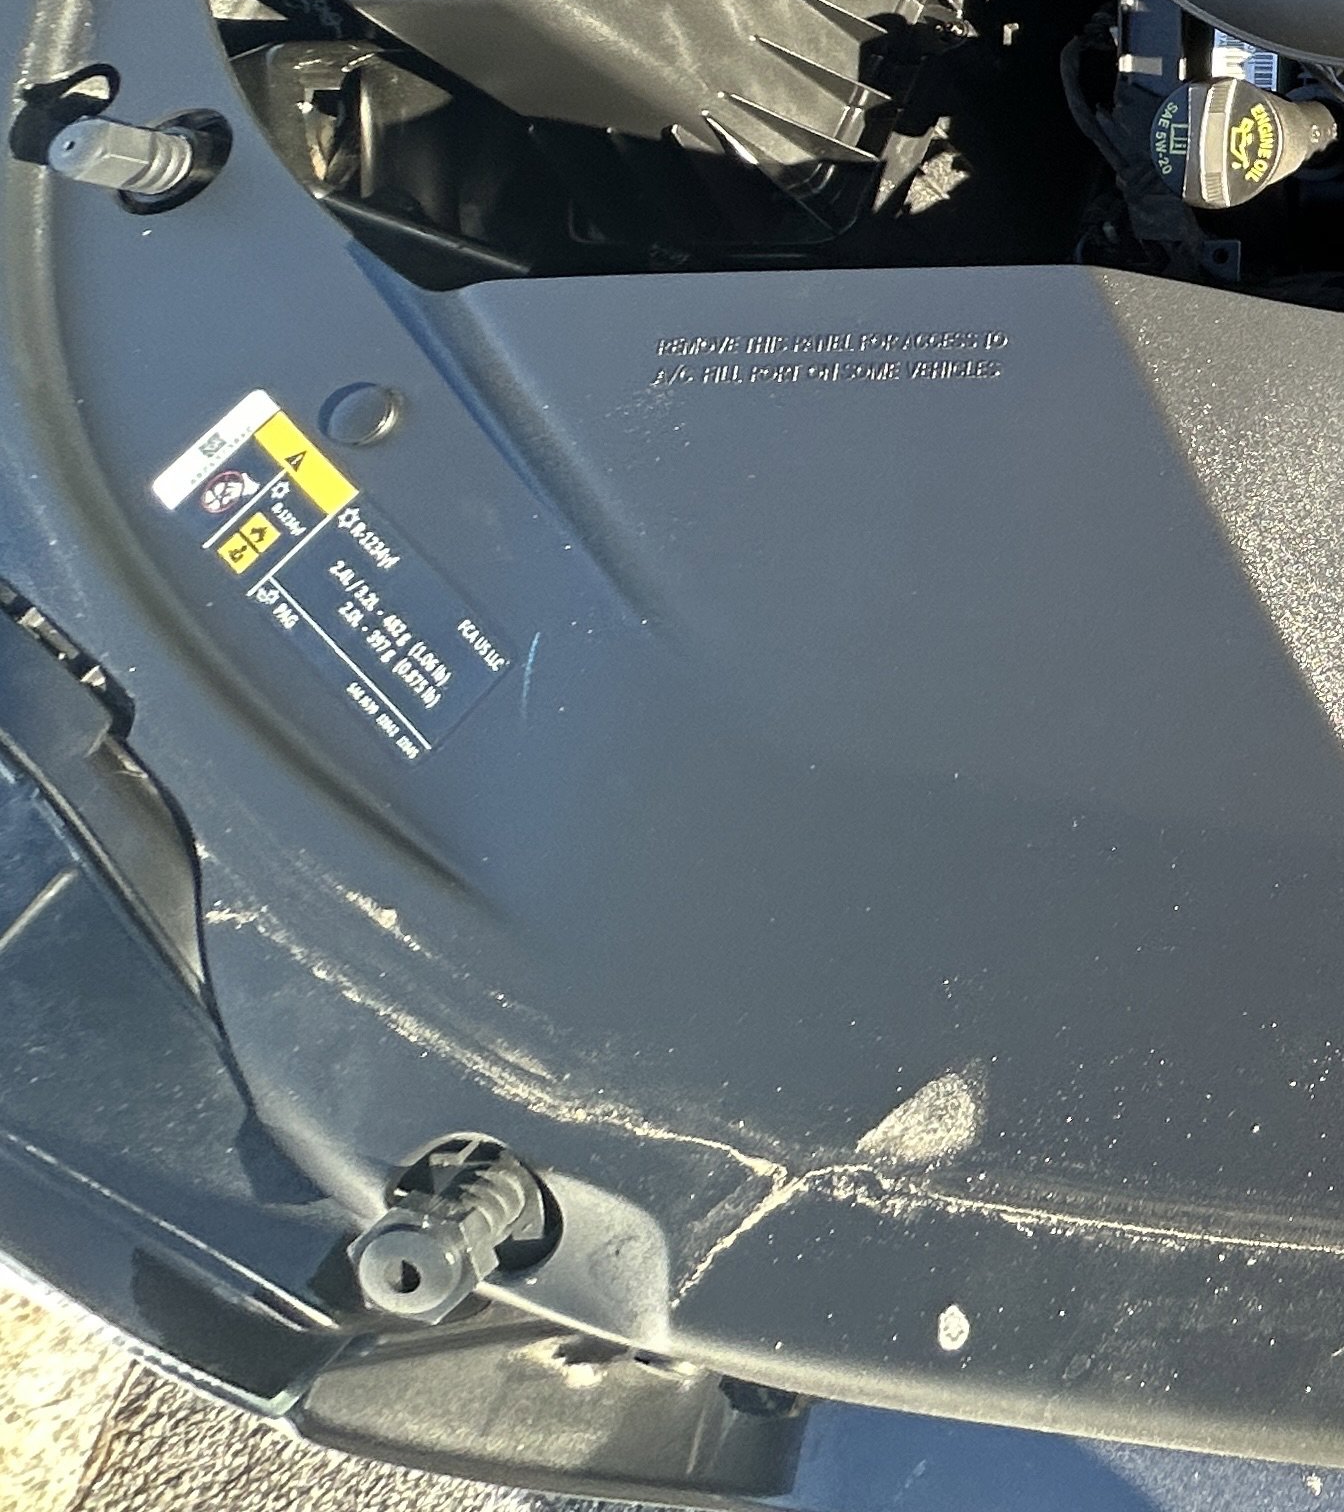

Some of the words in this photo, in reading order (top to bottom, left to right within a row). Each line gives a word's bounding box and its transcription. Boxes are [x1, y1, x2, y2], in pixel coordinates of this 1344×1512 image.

[1158, 101, 1178, 129] SAE
[1250, 103, 1275, 159] ENGINE
[1154, 131, 1173, 175] 5W-20
[1244, 159, 1269, 183] OIL
[657, 336, 741, 357] REMOVE
[746, 336, 788, 355] THIS
[793, 333, 856, 354] PANEL
[860, 333, 900, 352] FOR
[902, 331, 979, 351] ACCESS
[983, 330, 1009, 350] TO
[650, 364, 694, 387] A/C
[702, 364, 743, 384] FILL
[750, 363, 803, 383] PORT
[807, 362, 841, 382] ON
[843, 361, 901, 381] SOME
[906, 359, 1002, 380] VEHICLES
[457, 619, 480, 644] FCA
[473, 636, 492, 656] US
[484, 649, 505, 672] LLC
